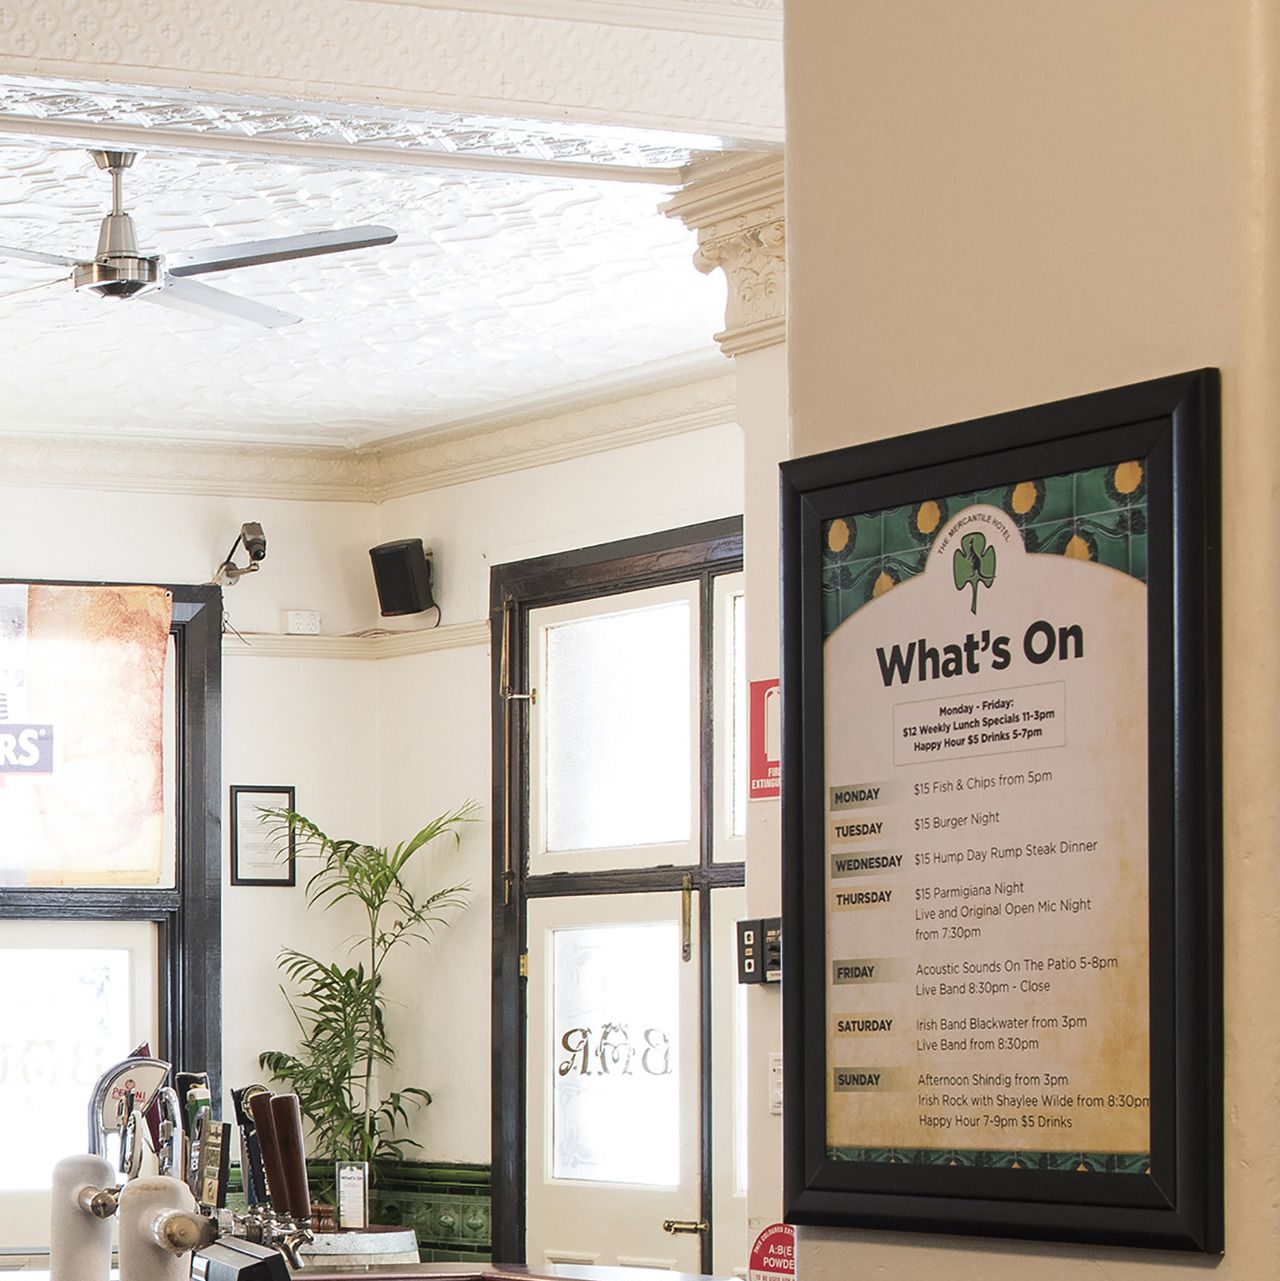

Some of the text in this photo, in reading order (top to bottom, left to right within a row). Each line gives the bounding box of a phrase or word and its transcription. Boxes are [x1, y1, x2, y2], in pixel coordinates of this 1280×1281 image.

[938, 513, 1012, 554] THE MERCANTILE HOTEL
[876, 620, 1084, 687] What's On
[939, 703, 974, 717] Monday
[982, 699, 1014, 712] Friday:
[903, 709, 1055, 738] $12 Weekly Lunch Specials 11-3pm
[914, 727, 1043, 752] Happy Hour $5 Drinks 5-7pm
[914, 770, 1053, 796] $15 Fish & Chips from 5pm
[835, 787, 880, 804] MONDAY
[914, 811, 1000, 831] $15 Burger Night
[835, 822, 883, 838] TUESDAY
[914, 840, 1098, 866] $15 Hump Day Rump Steak Dinner
[836, 854, 903, 872] WEDNESDAY
[836, 890, 893, 906] THURSDAY
[914, 882, 1025, 901] $15 Parmigiana Night
[915, 898, 1092, 921] Live and Original Open Mic Night
[915, 926, 981, 941] from 7:30pm
[837, 966, 875, 979] FRIDAY
[916, 956, 1119, 976] Acoustic Sounds On The Patio 5-8pm
[916, 983, 937, 996] Live
[940, 983, 966, 995] Band
[969, 981, 1010, 995] 8:30pm
[1020, 979, 1051, 993] Close
[837, 1019, 893, 1033] SATURDAY
[917, 1015, 1088, 1031] Irish Band Blackwater from 3pm
[917, 1037, 1040, 1051] Live Band from 8:30pm
[838, 1074, 881, 1086] SUNDAY
[918, 1073, 1069, 1088] Afternoon Shindig from 3pm
[112, 1087, 146, 1099] PENI
[919, 1094, 940, 1106] Irish
[942, 1094, 968, 1106] Rock
[971, 1094, 994, 1106] with
[996, 1094, 1038, 1109] Shaylee
[1041, 1094, 1074, 1107] Wilde
[1077, 1094, 1105, 1107] from
[919, 1115, 1073, 1129] Happy Hour 7-9pm $5 Drinks
[768, 1244, 793, 1257] A:B(E
[763, 1257, 795, 1270] POWDE
